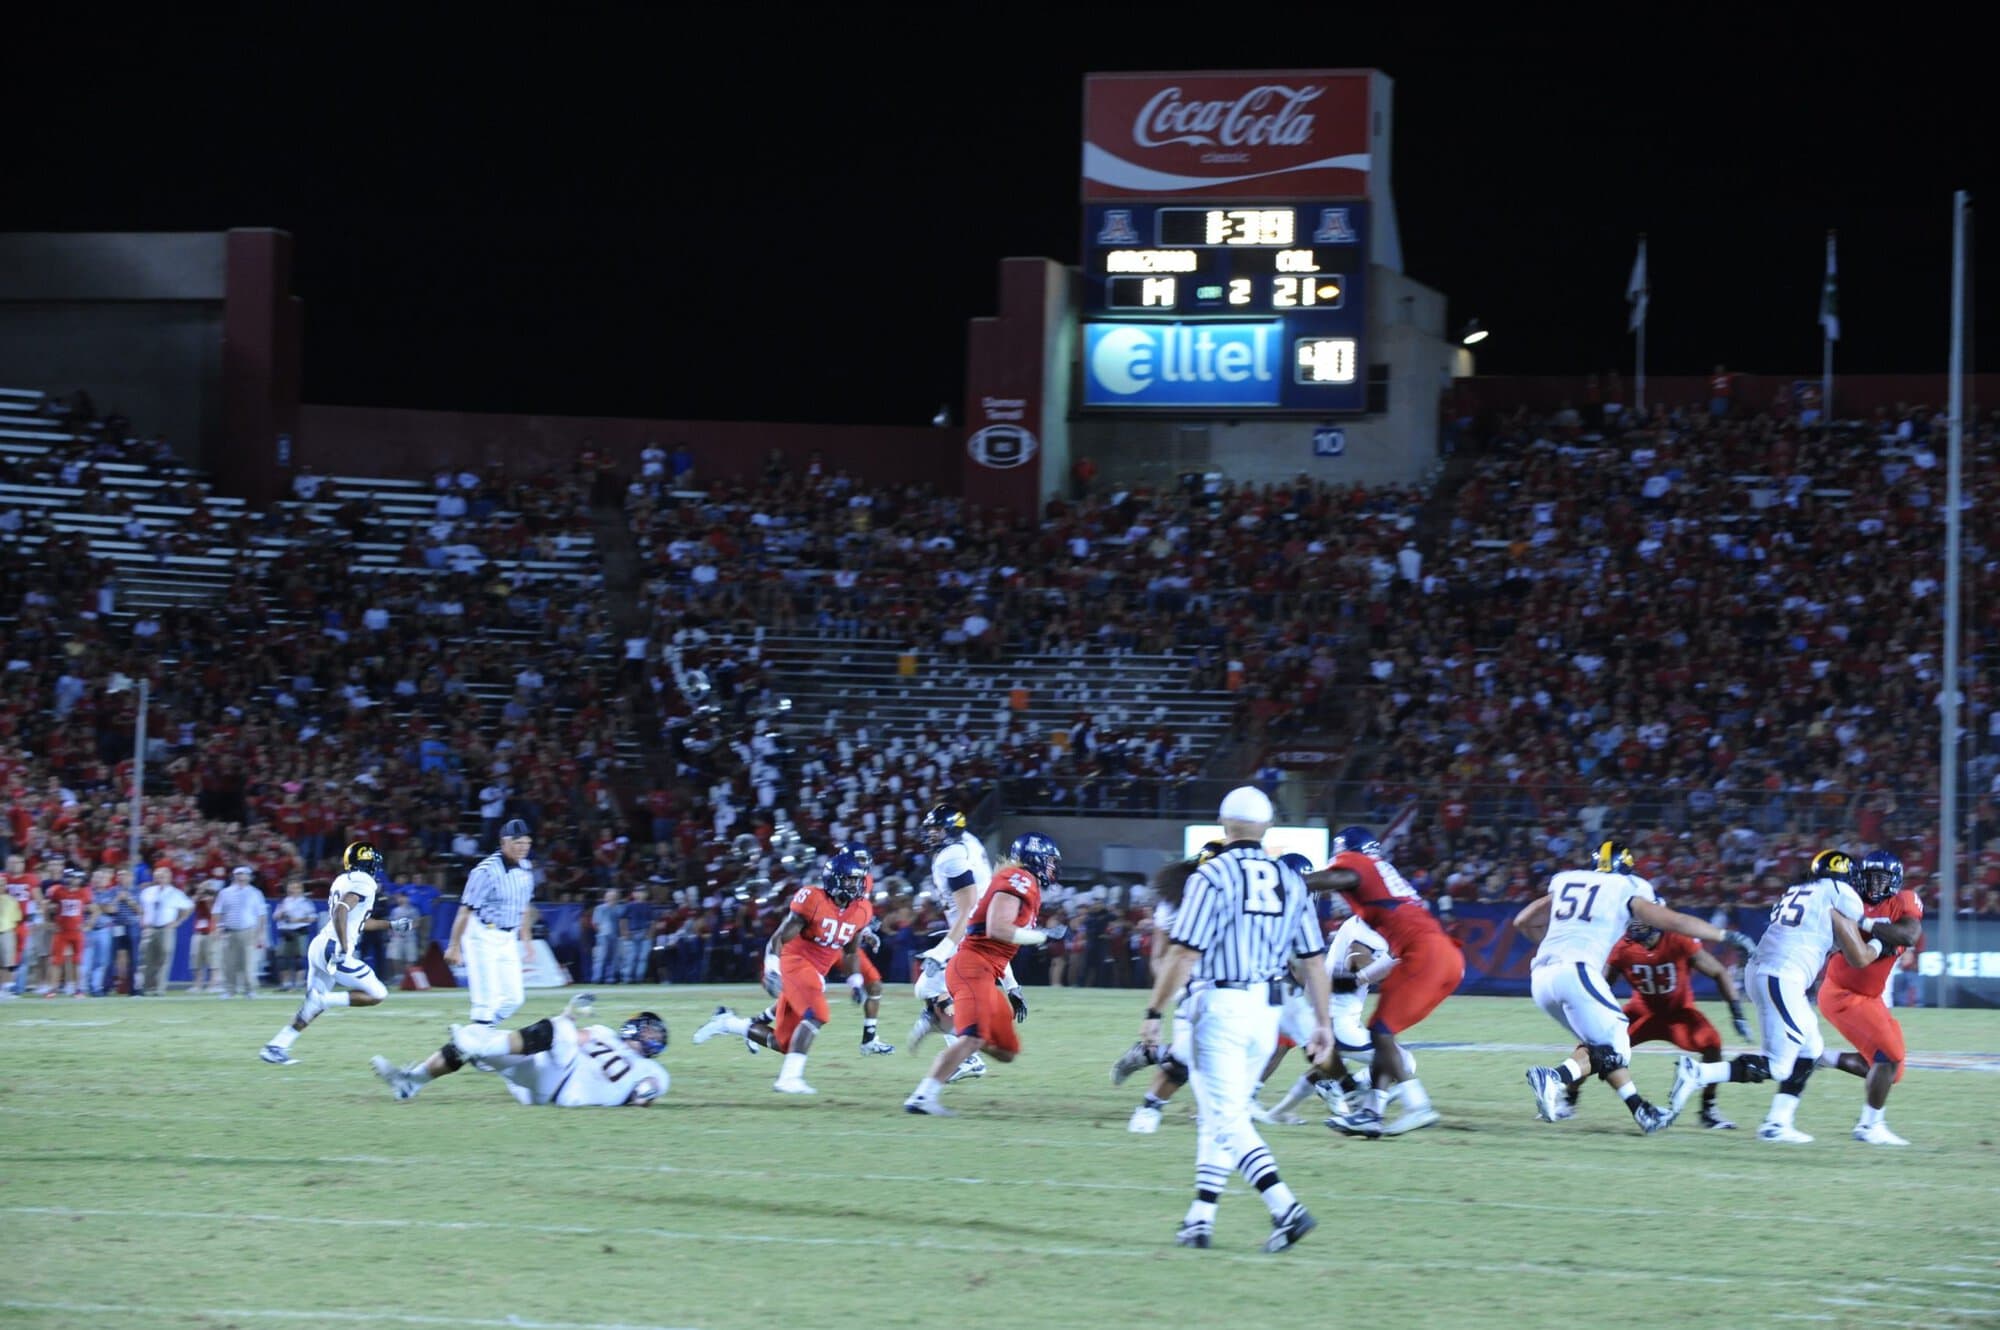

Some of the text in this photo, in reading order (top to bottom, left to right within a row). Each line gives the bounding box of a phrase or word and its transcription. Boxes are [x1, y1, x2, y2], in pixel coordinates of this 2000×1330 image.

[1133, 85, 1327, 147] Coca-Cola
[1229, 279, 1251, 304] 2
[1273, 277, 1316, 306] 21
[1313, 433, 1344, 453] 10
[1241, 858, 1282, 913] R
[1555, 883, 1600, 922] 51
[814, 917, 857, 949] 35
[1632, 963, 1677, 994] 33
[589, 1041, 631, 1083] 70
